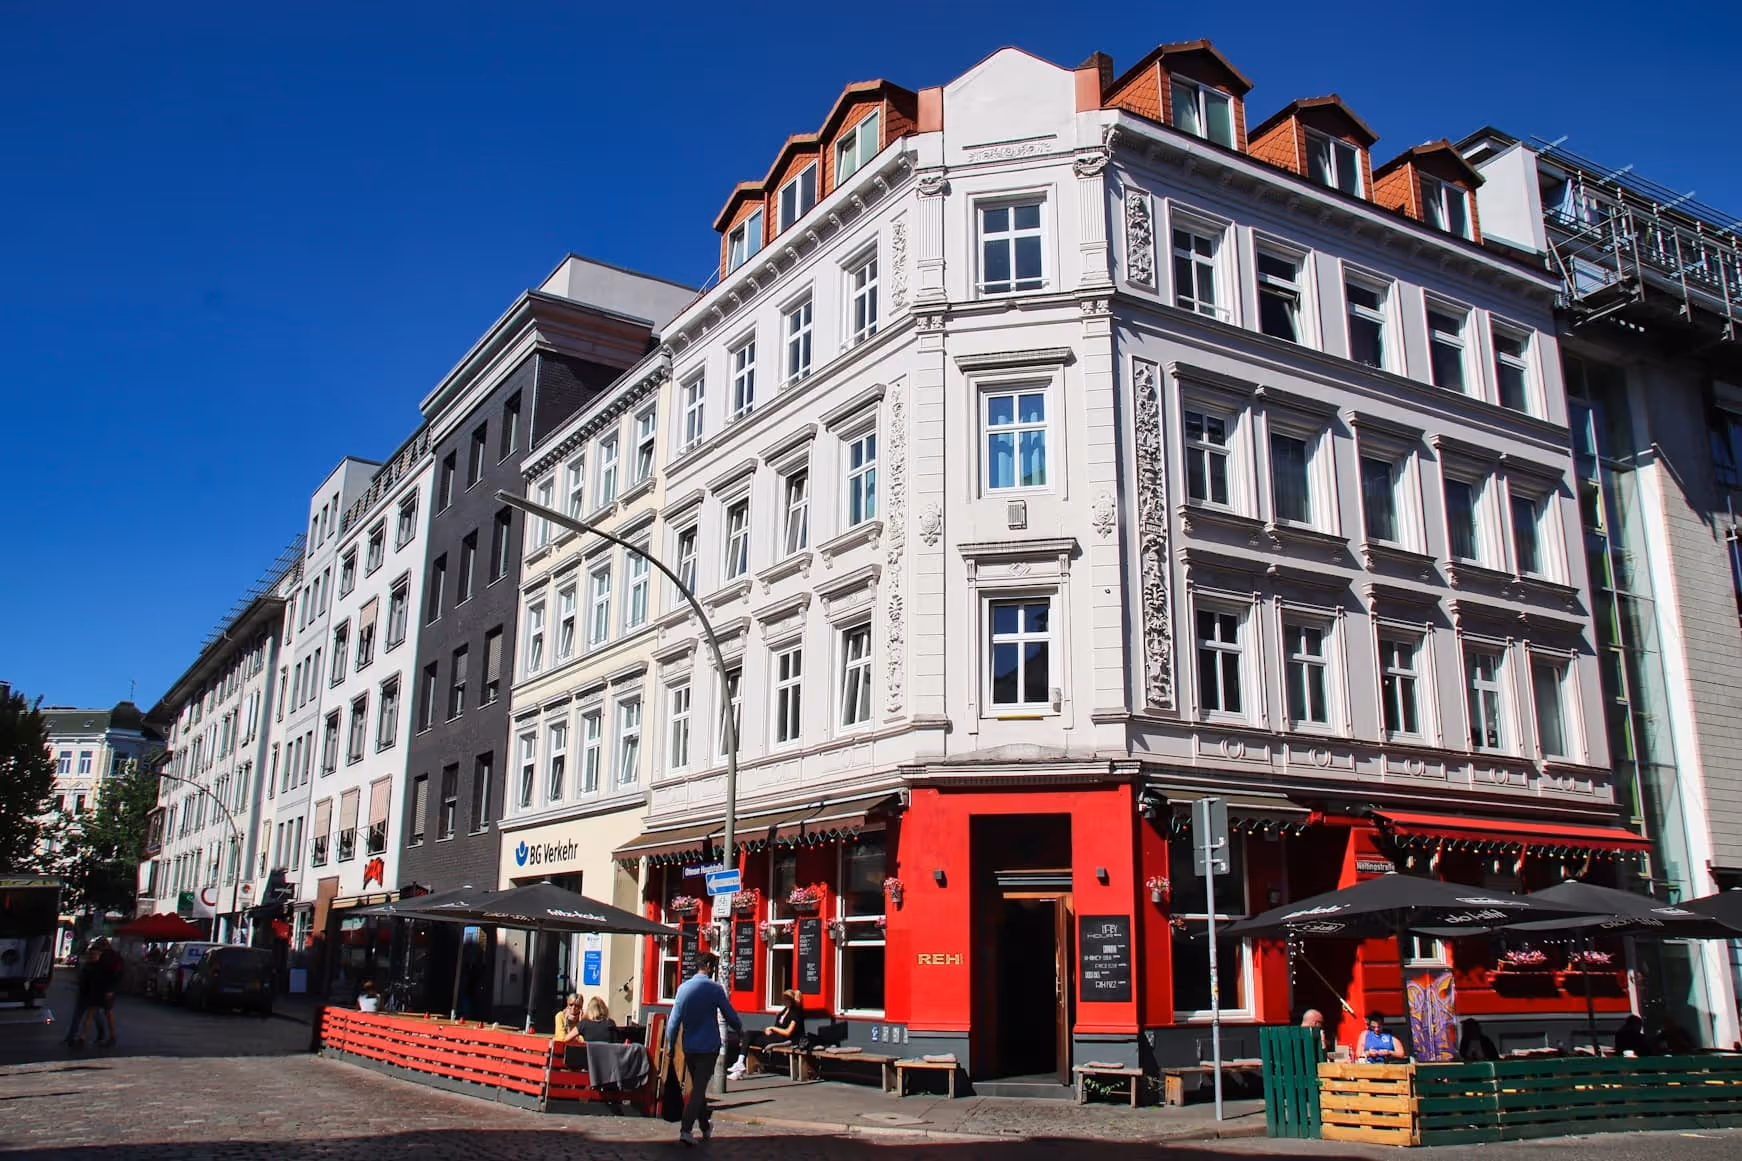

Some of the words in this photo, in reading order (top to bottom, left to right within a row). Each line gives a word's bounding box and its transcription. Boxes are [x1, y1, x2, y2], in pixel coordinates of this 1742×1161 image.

[530, 844, 542, 865] BG
[544, 838, 579, 864] Verkehr
[918, 953, 960, 965] REH
